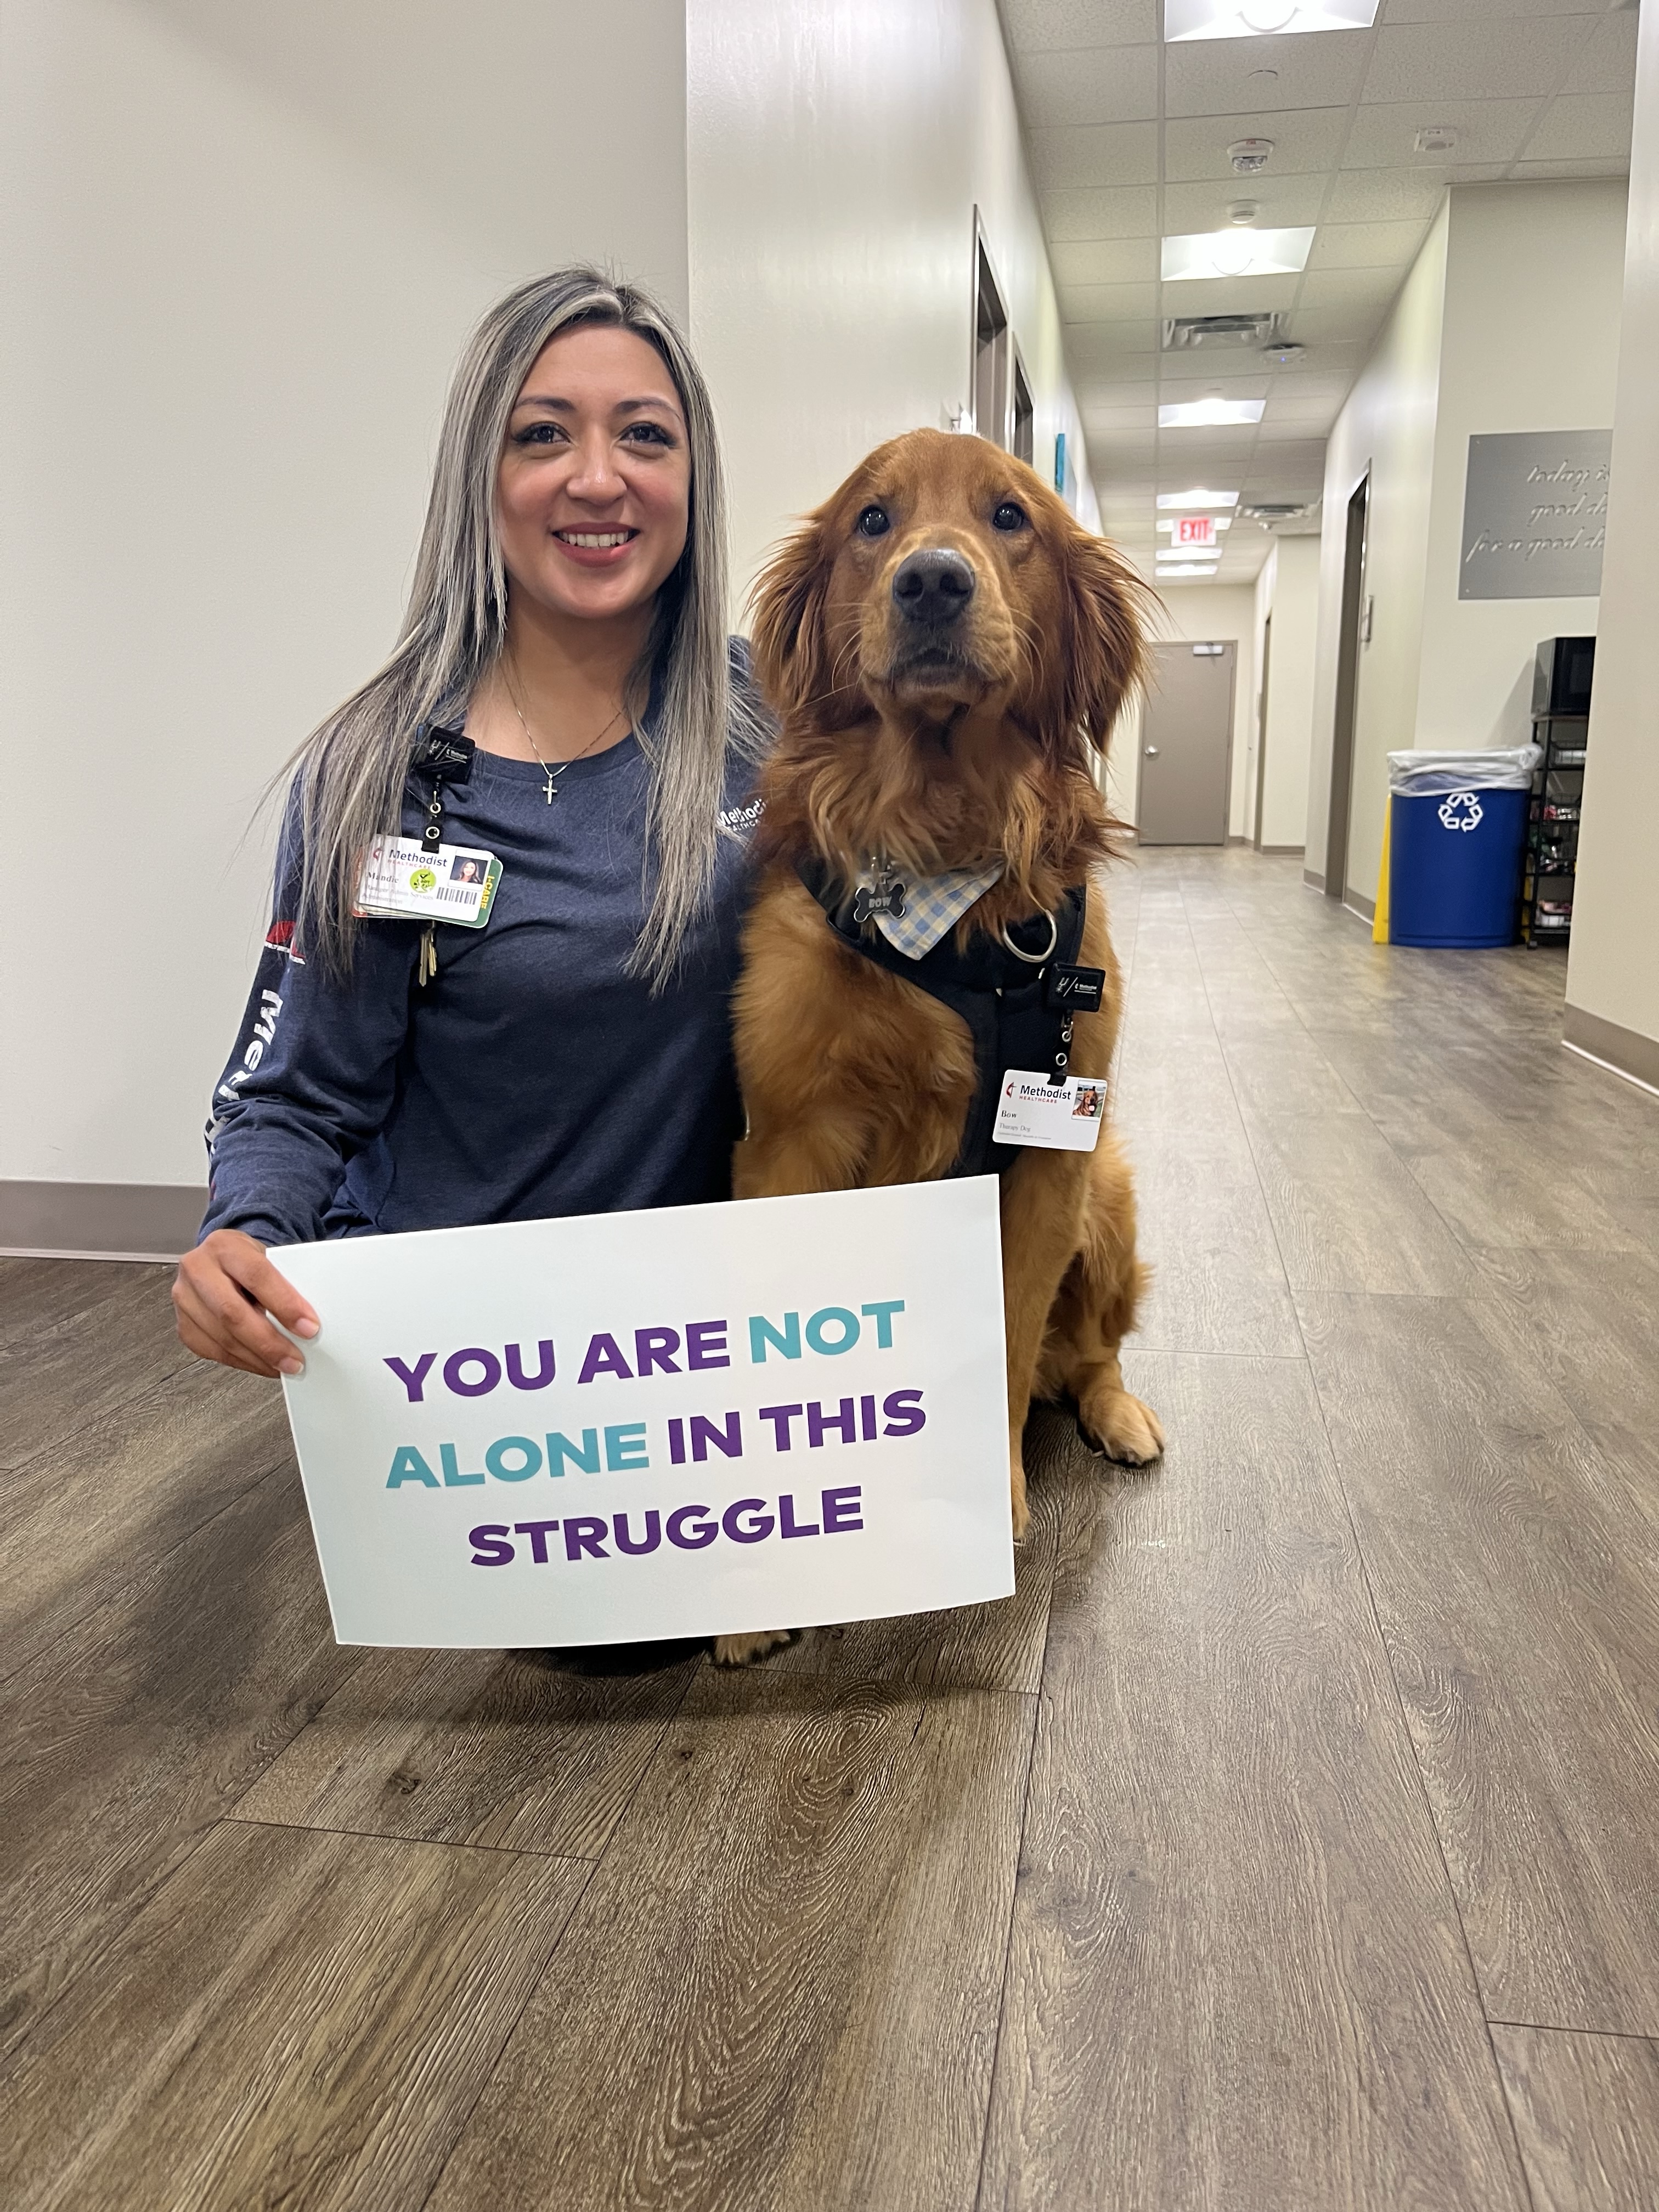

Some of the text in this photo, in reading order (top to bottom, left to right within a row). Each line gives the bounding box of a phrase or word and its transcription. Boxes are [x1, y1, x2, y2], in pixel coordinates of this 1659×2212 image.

[1527, 459, 1590, 492] today
[1526, 492, 1587, 527] good
[1180, 519, 1210, 541] EXIT
[1465, 529, 1504, 563] for
[1508, 539, 1523, 551] a
[1524, 526, 1585, 561] good
[389, 849, 448, 867] Methodist
[868, 896, 893, 908] BOW
[1019, 1096, 1057, 1104] HEALTHCARE
[1020, 1085, 1071, 1099] Methodist
[1001, 1110, 1017, 1118] Bow
[382, 1300, 905, 1402] YOU ARE NOT
[386, 1390, 926, 1488] ALONE IN THIS
[469, 1486, 863, 1566] STRUGGLE
